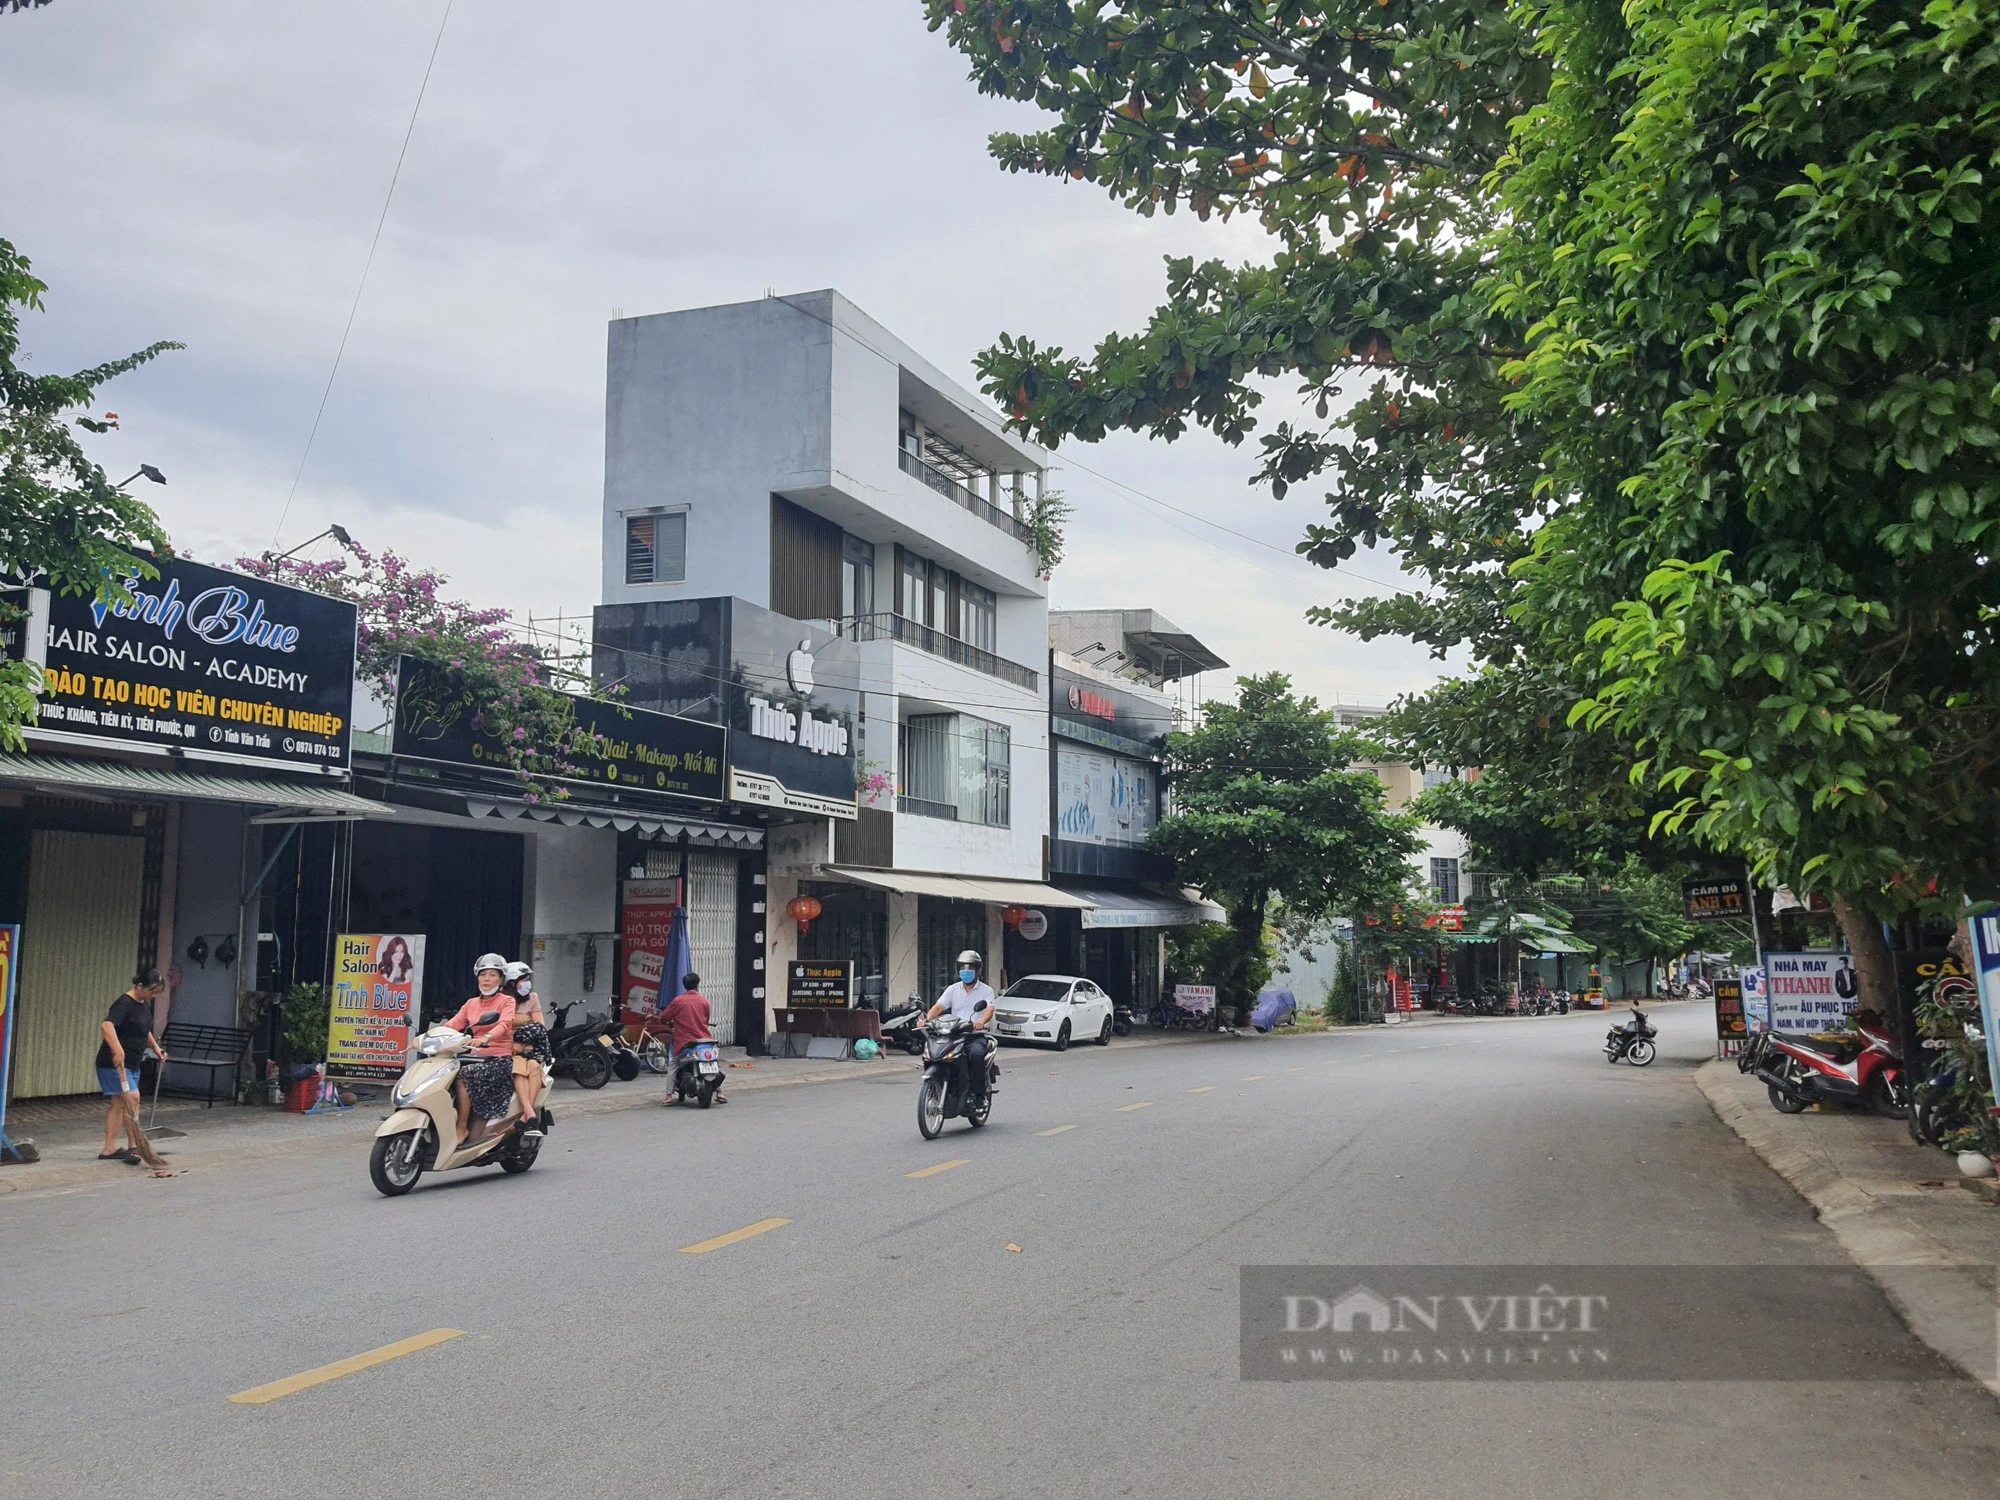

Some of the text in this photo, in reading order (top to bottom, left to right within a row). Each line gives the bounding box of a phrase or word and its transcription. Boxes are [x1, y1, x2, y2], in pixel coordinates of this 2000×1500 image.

[186, 585, 300, 652] Blue
[105, 636, 185, 671] SALON
[205, 656, 309, 693] ACADEMY
[92, 675, 129, 706] TẠO
[134, 683, 171, 713] HỌC
[177, 689, 215, 717] VIÊN
[220, 698, 284, 727] CHUYÊN
[288, 710, 343, 739] NGHIỆP
[1080, 689, 1116, 721] YAMAHA
[42, 702, 64, 719] THÚC
[67, 706, 98, 726] KHÁNG,
[101, 711, 119, 727] TIÊN
[184, 724, 195, 738] QN
[750, 697, 847, 756] Thức Apple
[296, 740, 340, 758] 0974 974 123
[601, 737, 628, 760] Nail
[636, 744, 678, 772] Makeup
[343, 941, 371, 955] Hair
[342, 958, 377, 973] Salon
[823, 968, 842, 977] Apple
[1774, 958, 1827, 972] NHÀ MAY
[1186, 986, 1214, 995] YAMAHA
[1771, 977, 1833, 995] THANH
[336, 980, 408, 1011] Tỉnh Blue
[1801, 1000, 1813, 1013] ÂU
[1815, 1002, 1839, 1015] PHỤC
[365, 1028, 377, 1036] NAM
[1777, 1019, 1794, 1029] NAM,
[1806, 1018, 1819, 1030] HỢP
[339, 1040, 358, 1048] TRANG
